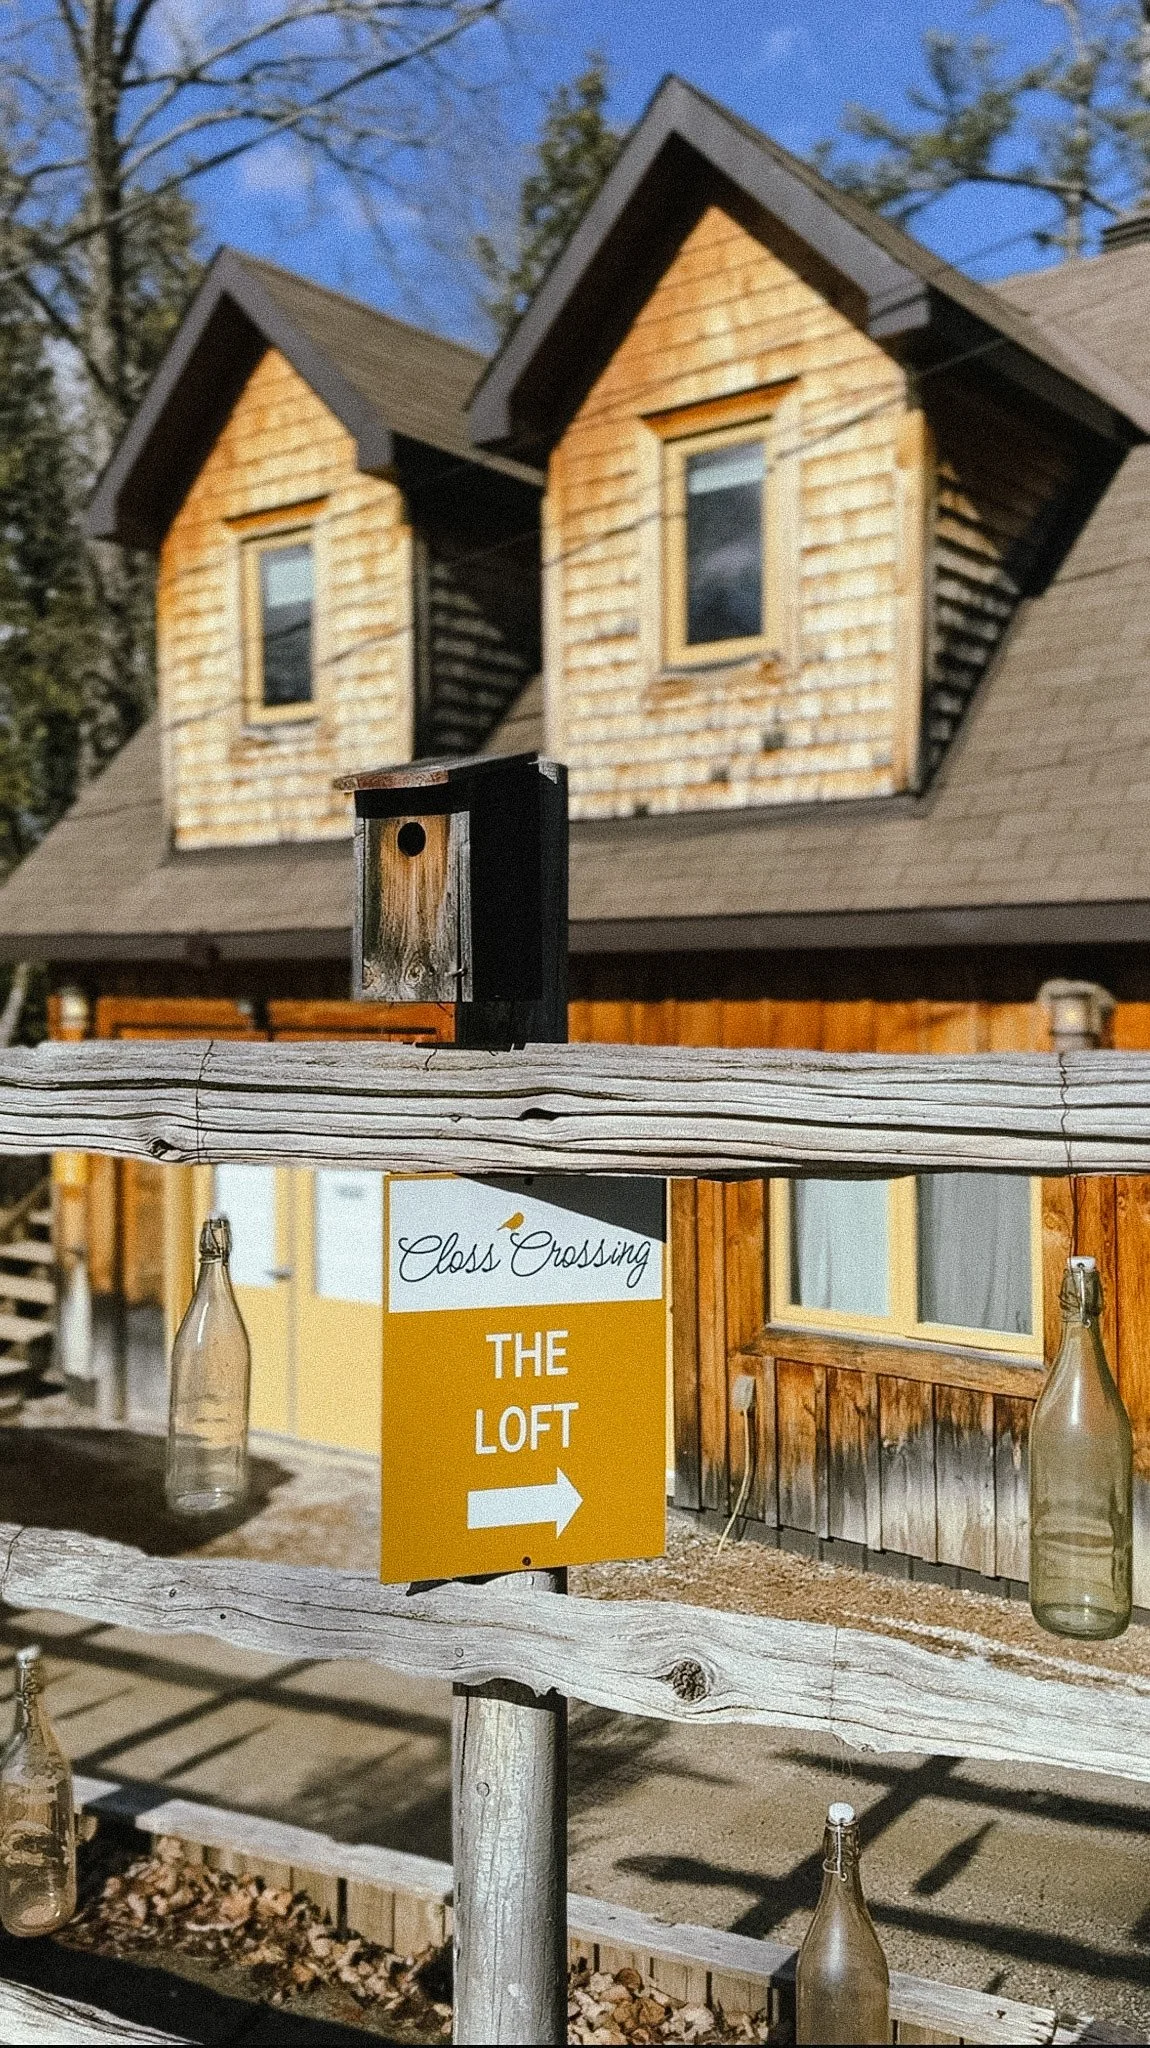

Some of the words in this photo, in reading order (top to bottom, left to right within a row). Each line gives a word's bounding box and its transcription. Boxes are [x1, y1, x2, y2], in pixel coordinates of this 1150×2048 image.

[398, 1232, 502, 1283] Closs
[510, 1230, 652, 1289] Crossing
[485, 1329, 569, 1379] THE
[475, 1402, 579, 1455] LOFT
